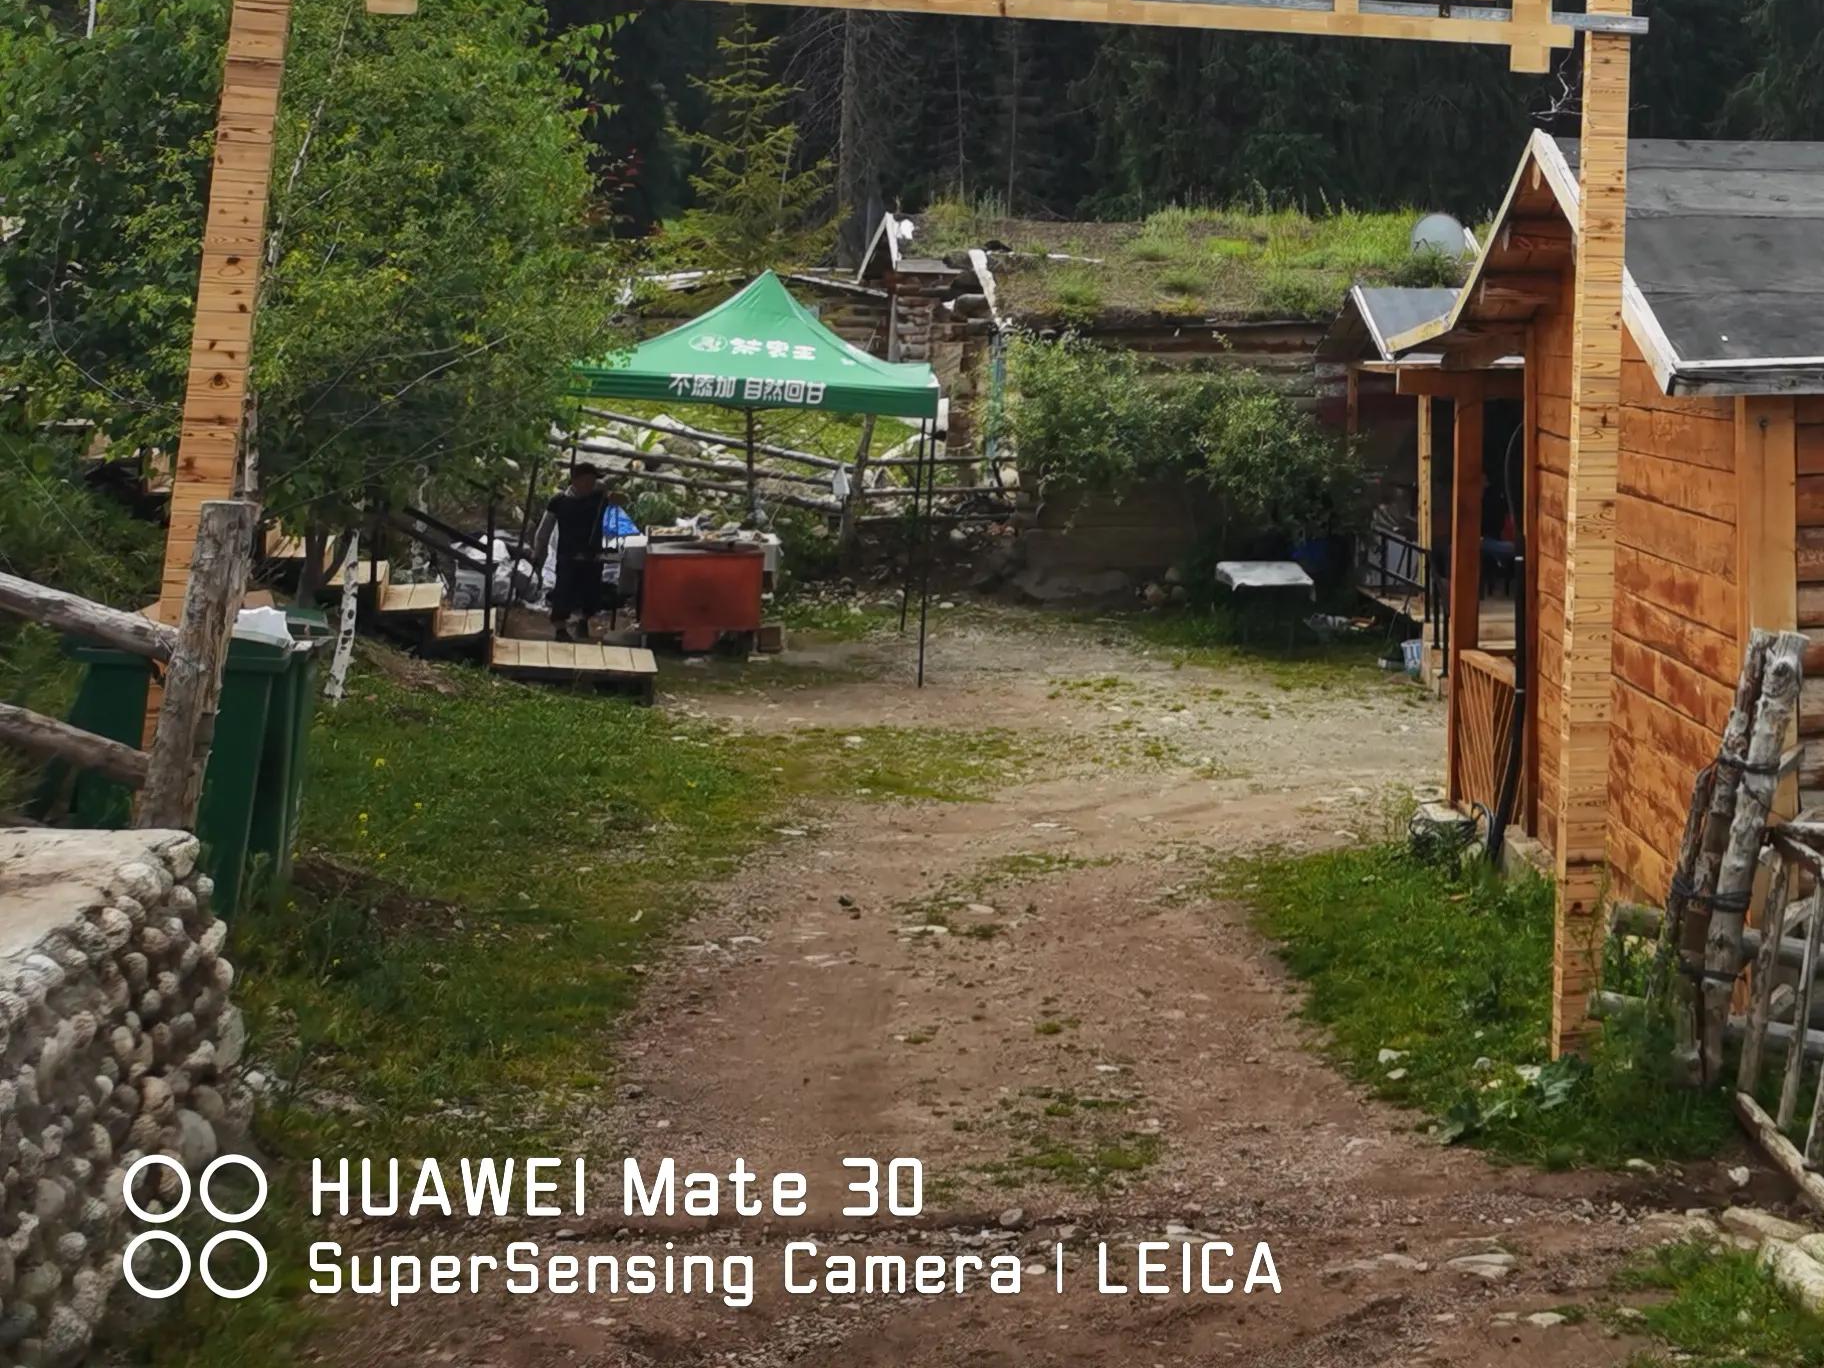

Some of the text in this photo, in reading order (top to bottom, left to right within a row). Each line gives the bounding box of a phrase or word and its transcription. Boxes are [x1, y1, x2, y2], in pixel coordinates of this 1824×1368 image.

[668, 373, 827, 405] 不添加 自然回甘
